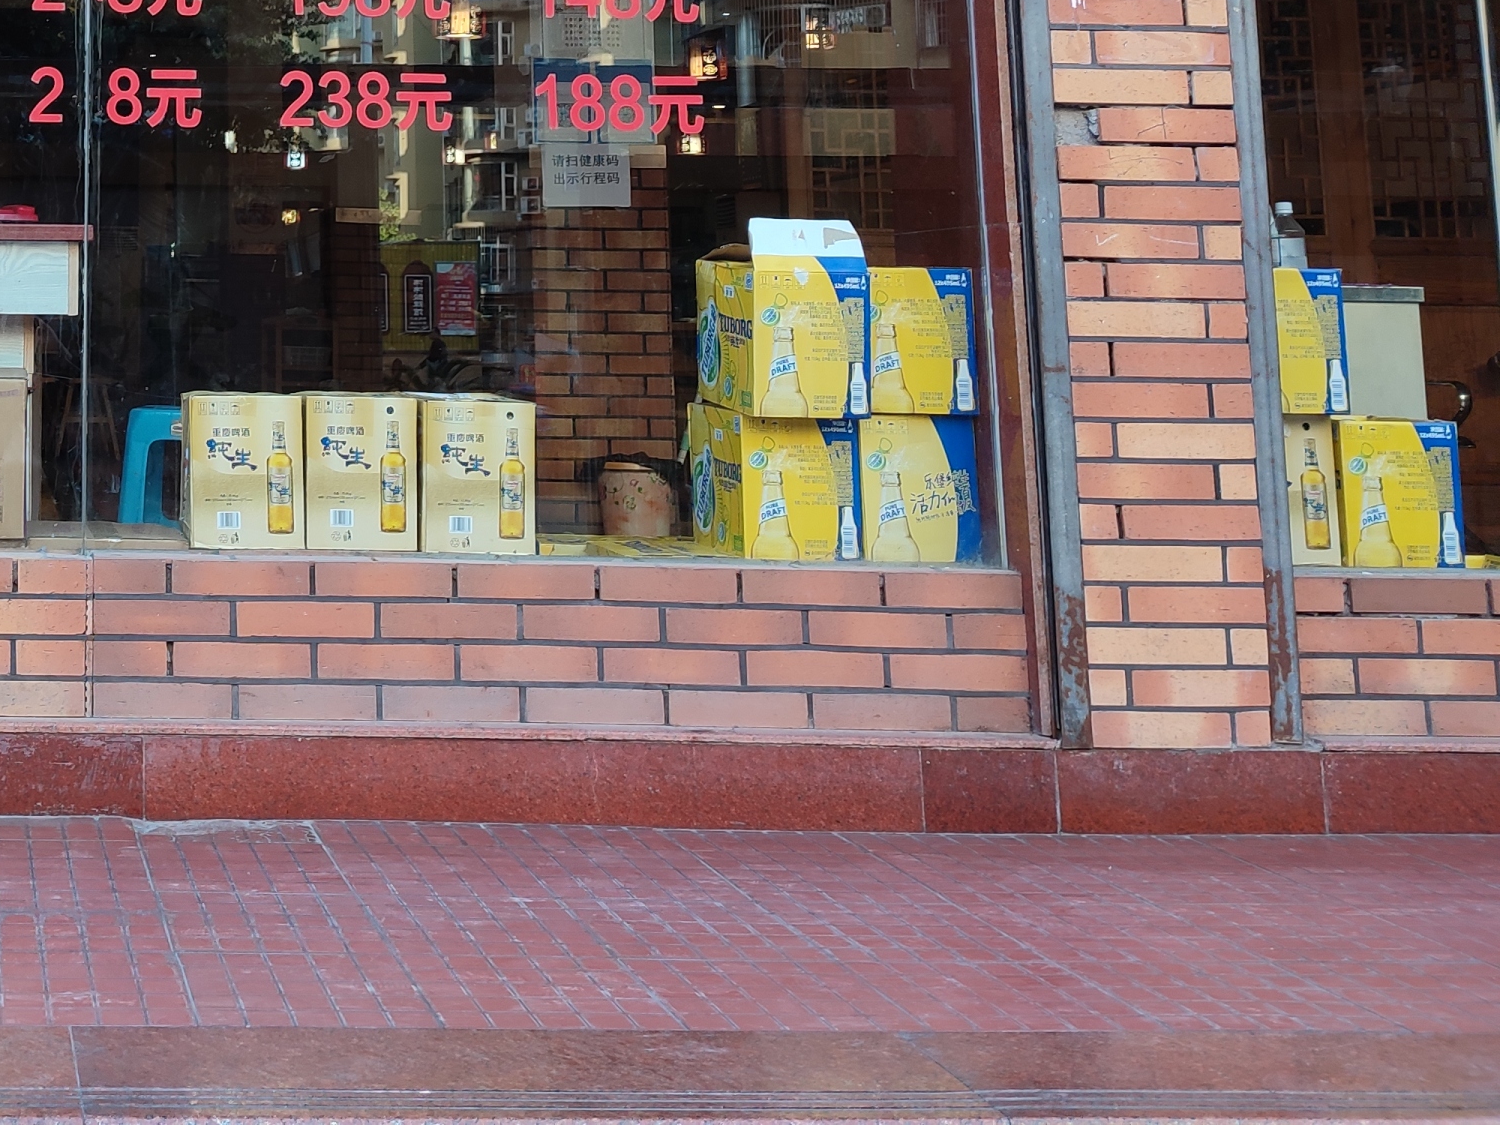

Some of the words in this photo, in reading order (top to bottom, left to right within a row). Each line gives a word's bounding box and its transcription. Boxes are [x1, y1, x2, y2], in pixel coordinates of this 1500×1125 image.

[28, 65, 203, 129] 28元
[278, 70, 454, 133] 238元
[534, 72, 706, 136] 188元
[551, 154, 620, 167] 请扫健康码
[553, 171, 621, 185] 出示行程码
[718, 312, 753, 340] TUBORG
[771, 361, 796, 376] DRAFT
[874, 358, 900, 373] DRAFT
[713, 457, 742, 484] TUBORG
[760, 506, 786, 521] DRAFT
[880, 507, 905, 521] DRAFT
[1362, 511, 1387, 526] DRAFT
